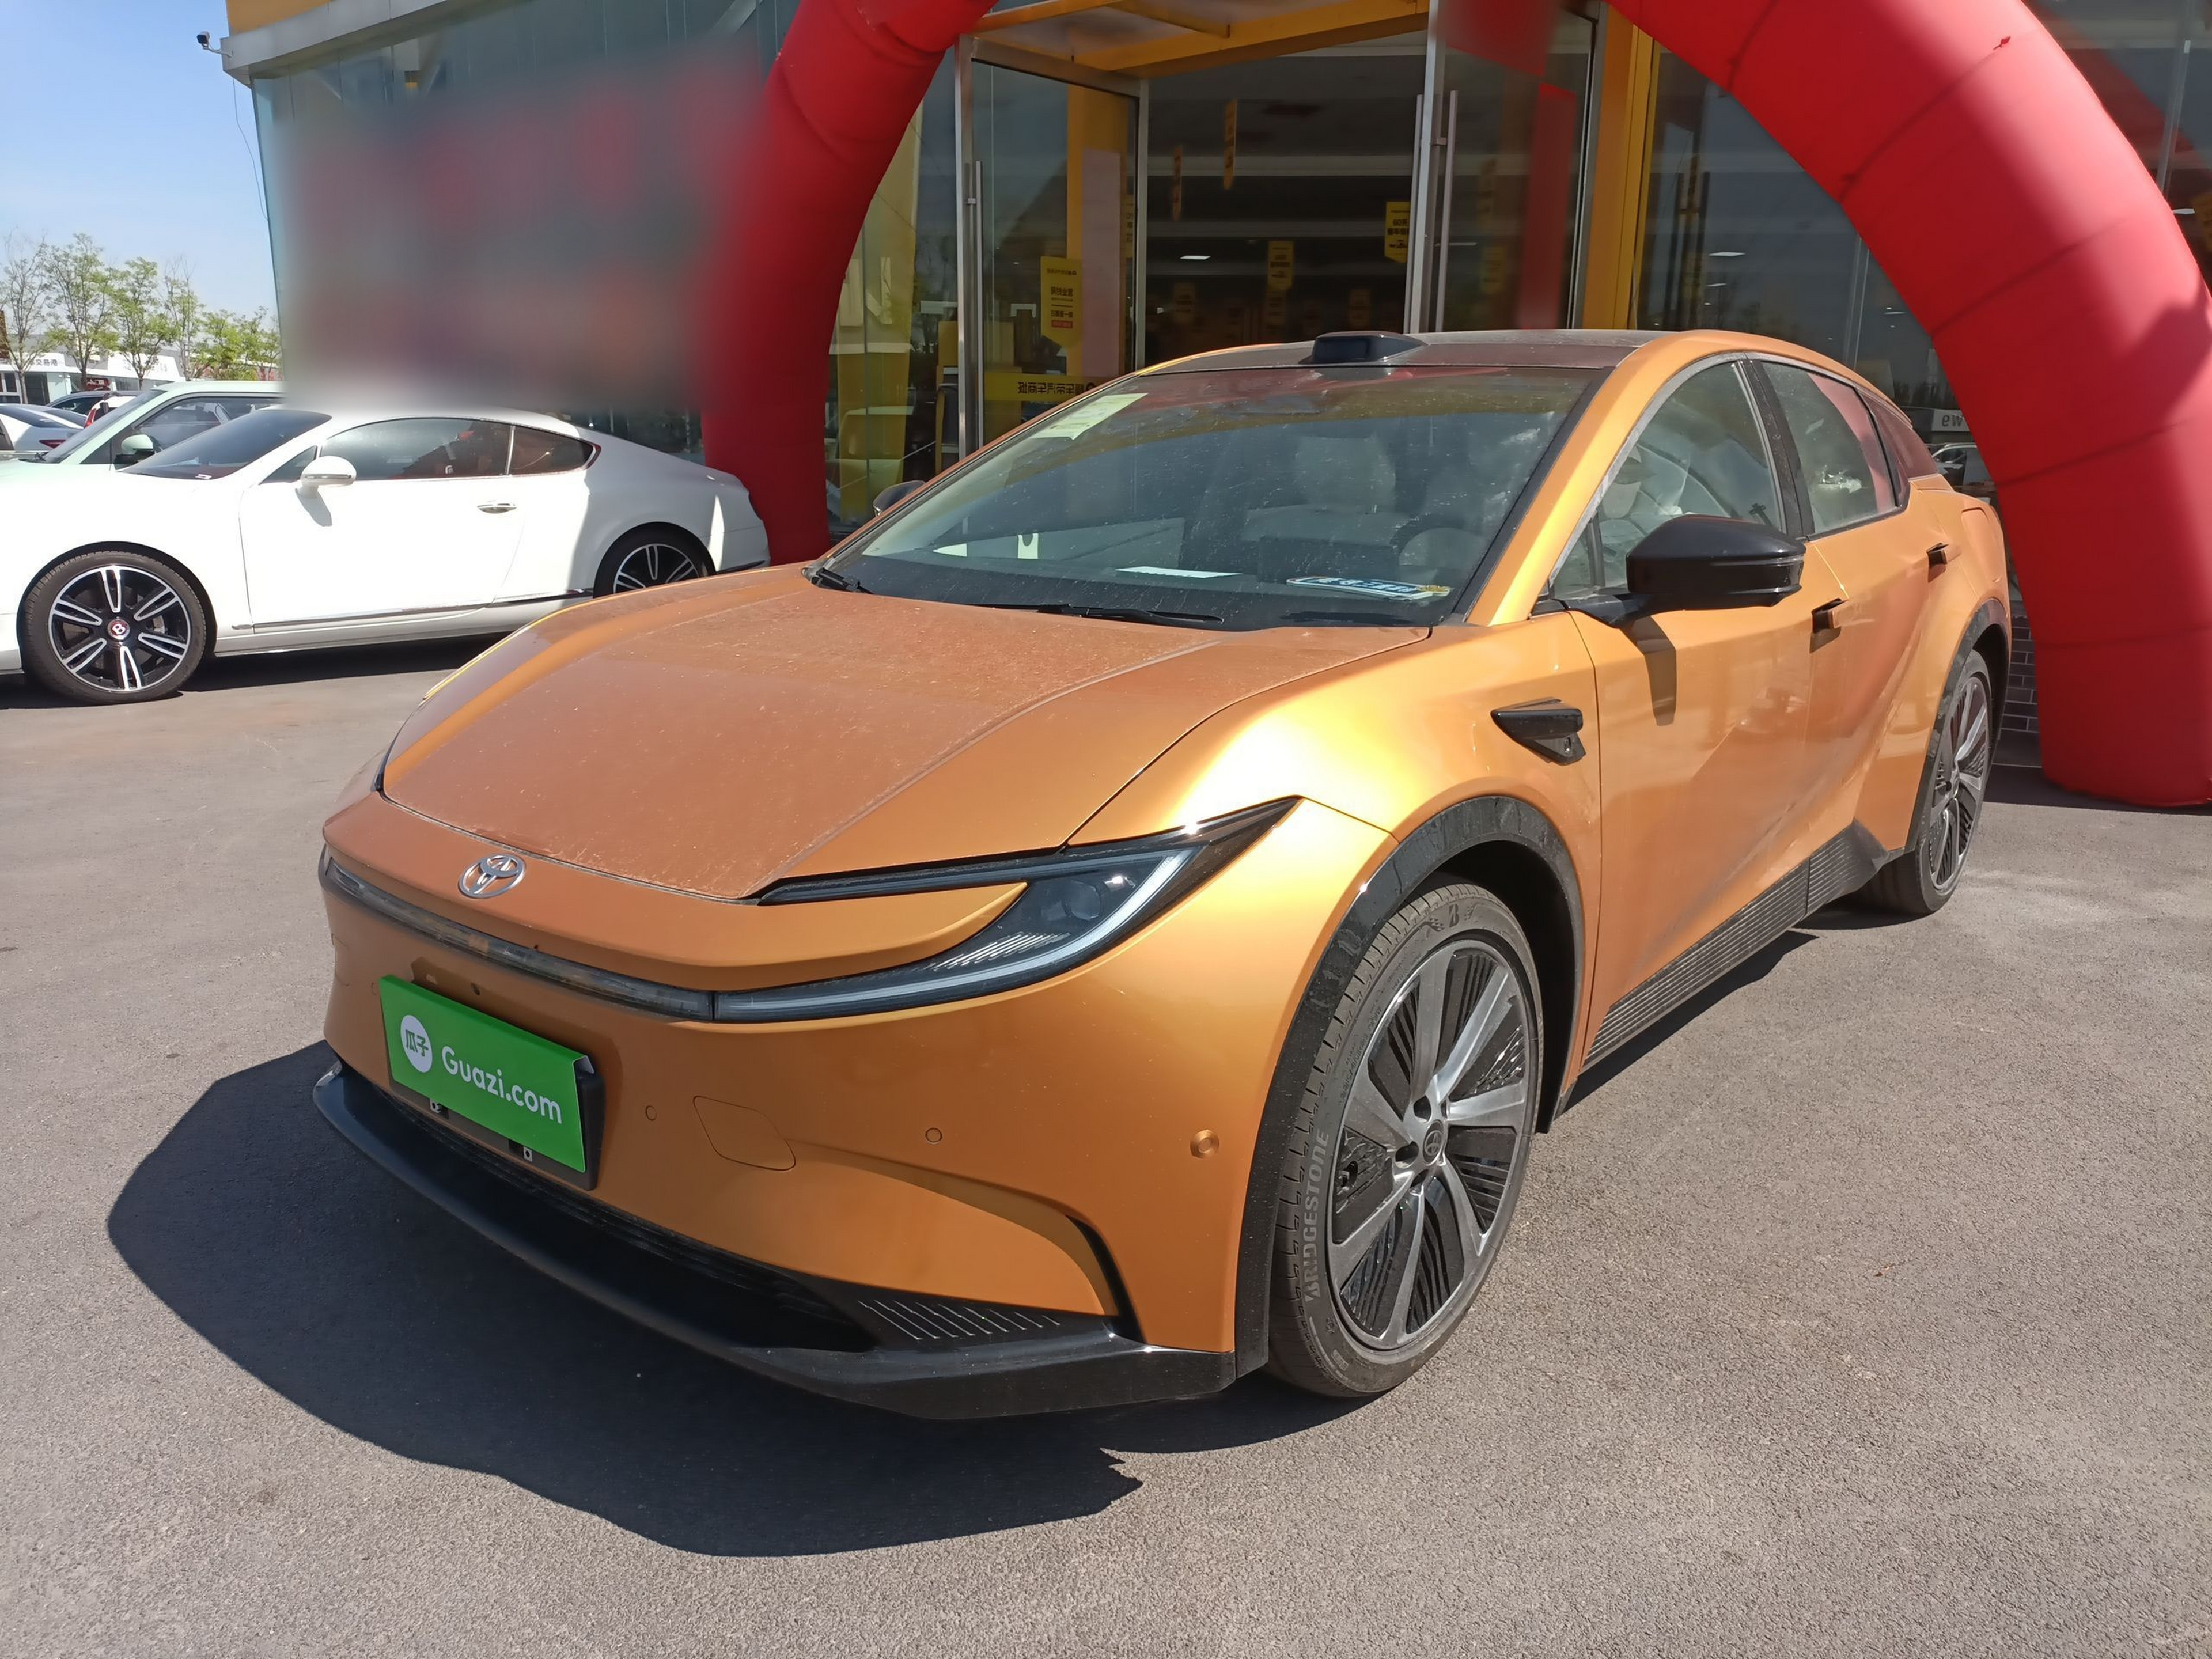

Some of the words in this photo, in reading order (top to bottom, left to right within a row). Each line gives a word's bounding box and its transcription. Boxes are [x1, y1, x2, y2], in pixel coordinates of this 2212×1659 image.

[30, 358, 58, 366] 交易港
[405, 1029, 429, 1058] 瓜子
[441, 1046, 562, 1124] Guazi.com
[1302, 1128, 1330, 1302] BRIDGESTONE
